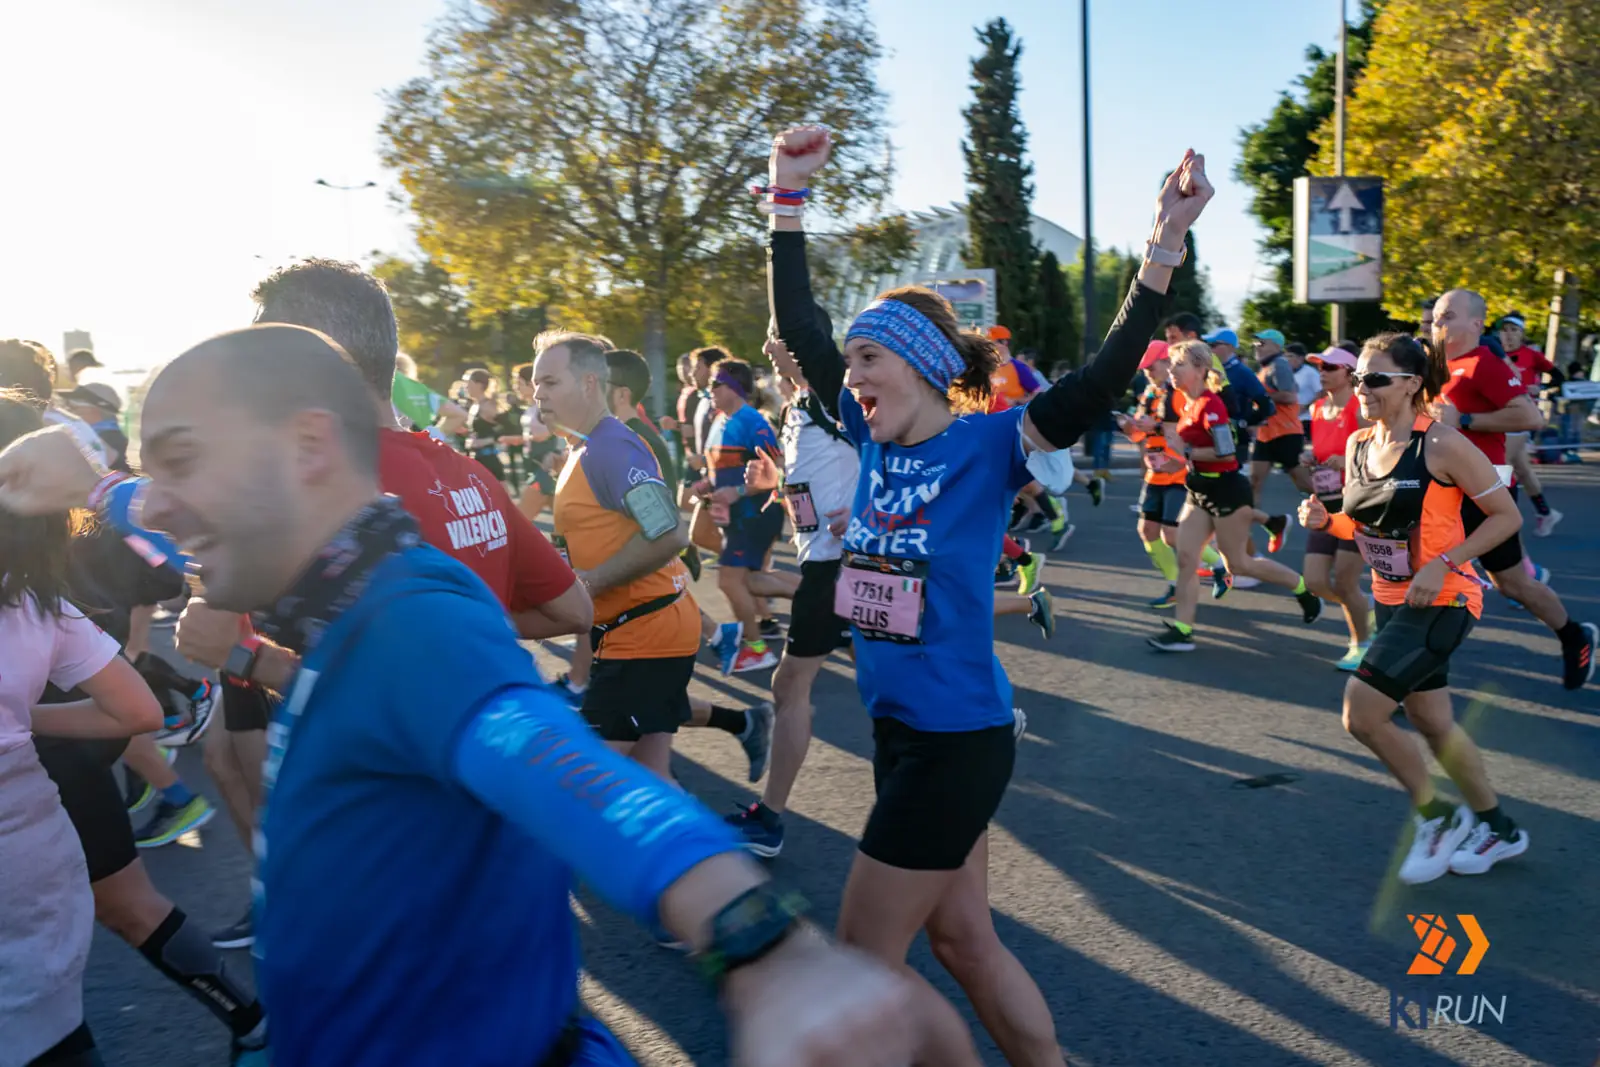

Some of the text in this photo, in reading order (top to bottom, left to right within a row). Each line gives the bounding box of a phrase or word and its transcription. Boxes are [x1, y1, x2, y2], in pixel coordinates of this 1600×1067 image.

[448, 485, 487, 517] RUN
[445, 509, 508, 550] VALENCIA
[853, 580, 894, 604] 17514
[851, 604, 890, 629] ELLIS
